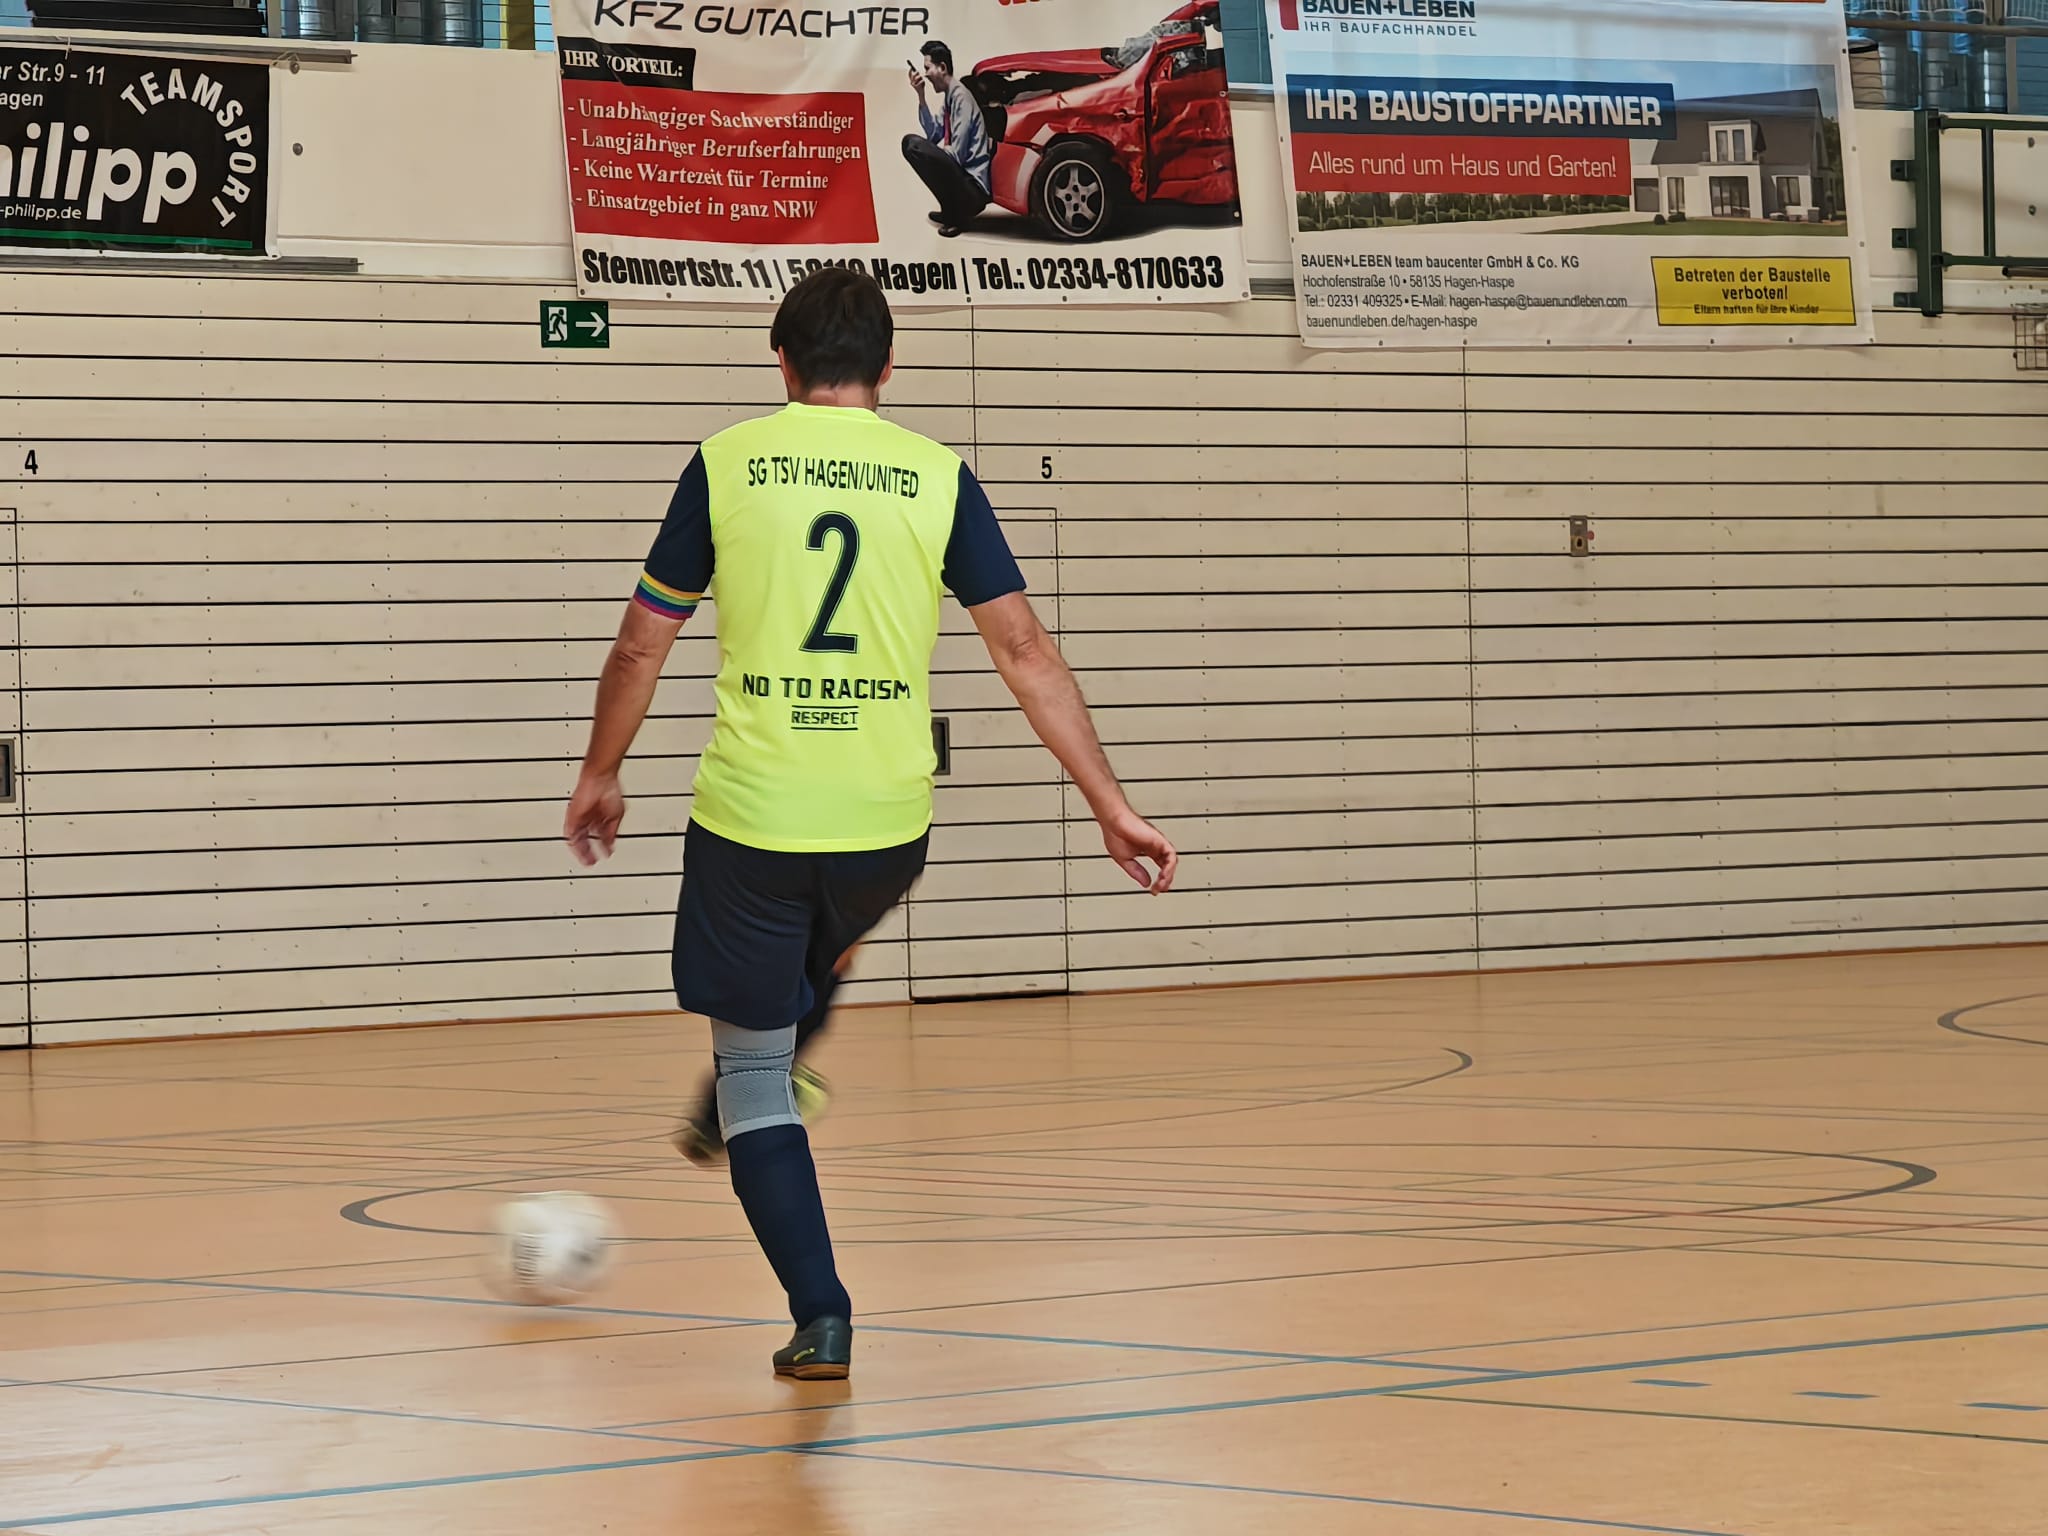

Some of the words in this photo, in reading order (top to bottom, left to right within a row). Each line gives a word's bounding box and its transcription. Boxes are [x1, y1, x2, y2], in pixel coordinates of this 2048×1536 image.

[595, 0, 682, 31] KFZ
[695, 6, 929, 38] GUTACHTER
[1303, 0, 1475, 18] BAUEN+LEBEN
[1304, 21, 1331, 32] IHR
[1340, 22, 1477, 37] BAUFACHHANDEL
[563, 50, 599, 67] IHR
[86, 65, 105, 85] 11
[1305, 88, 1358, 120] IHR
[1368, 90, 1662, 126] BAUSTOFFPARTNER
[710, 109, 854, 134] Sachverständiger
[120, 68, 257, 228] TEAMSPORT
[582, 128, 697, 159] Langjähriger
[702, 138, 861, 164] Berufserfahrungen
[584, 158, 633, 179] Keine
[637, 163, 724, 186] Wartezeit
[727, 169, 755, 188] für
[760, 170, 829, 189] Termine
[1309, 151, 1354, 174] Alles
[1361, 152, 1406, 175] rund
[1413, 159, 1444, 176] um
[1450, 152, 1500, 177] Haus
[1507, 155, 1541, 177] und
[1548, 154, 1617, 178] Garten!
[587, 188, 702, 217] Einsatzgebiet
[707, 196, 725, 215] in
[730, 201, 770, 221] ganz
[772, 200, 818, 219] NRW
[582, 248, 742, 288] Stennertstr.
[741, 259, 772, 289] 11
[871, 256, 957, 294] Hagen
[972, 258, 1025, 290] Tel.:
[1027, 255, 1224, 290] 02334-8170633
[1301, 254, 1392, 268] BAUEN+LEBEN
[1395, 256, 1423, 268] team
[1426, 256, 1483, 269] baucenter
[1487, 256, 1522, 268] GmbH
[1526, 256, 1535, 268] &
[1537, 256, 1557, 268] Co.
[1561, 256, 1579, 268] KG
[1303, 274, 1386, 288] Hochofenstraße
[1389, 275, 1400, 288] 10
[1409, 275, 1441, 288] 58135
[1444, 275, 1515, 290] Hagen-Haspe
[1674, 267, 1735, 283] Betreten
[1740, 268, 1763, 283] der
[1768, 267, 1831, 283] Baustelle
[1327, 295, 1359, 307] 02331
[1362, 295, 1402, 307] 409325
[24, 449, 39, 475] 4
[1040, 455, 1053, 480] 5
[748, 457, 767, 487] SG
[771, 456, 801, 484] TSV
[804, 457, 919, 499] HAGEN/UNITED
[800, 510, 861, 655] 2
[742, 673, 770, 697] NO
[779, 677, 812, 698] TO
[820, 678, 911, 700] RACISM
[791, 710, 859, 725] RESPECT
